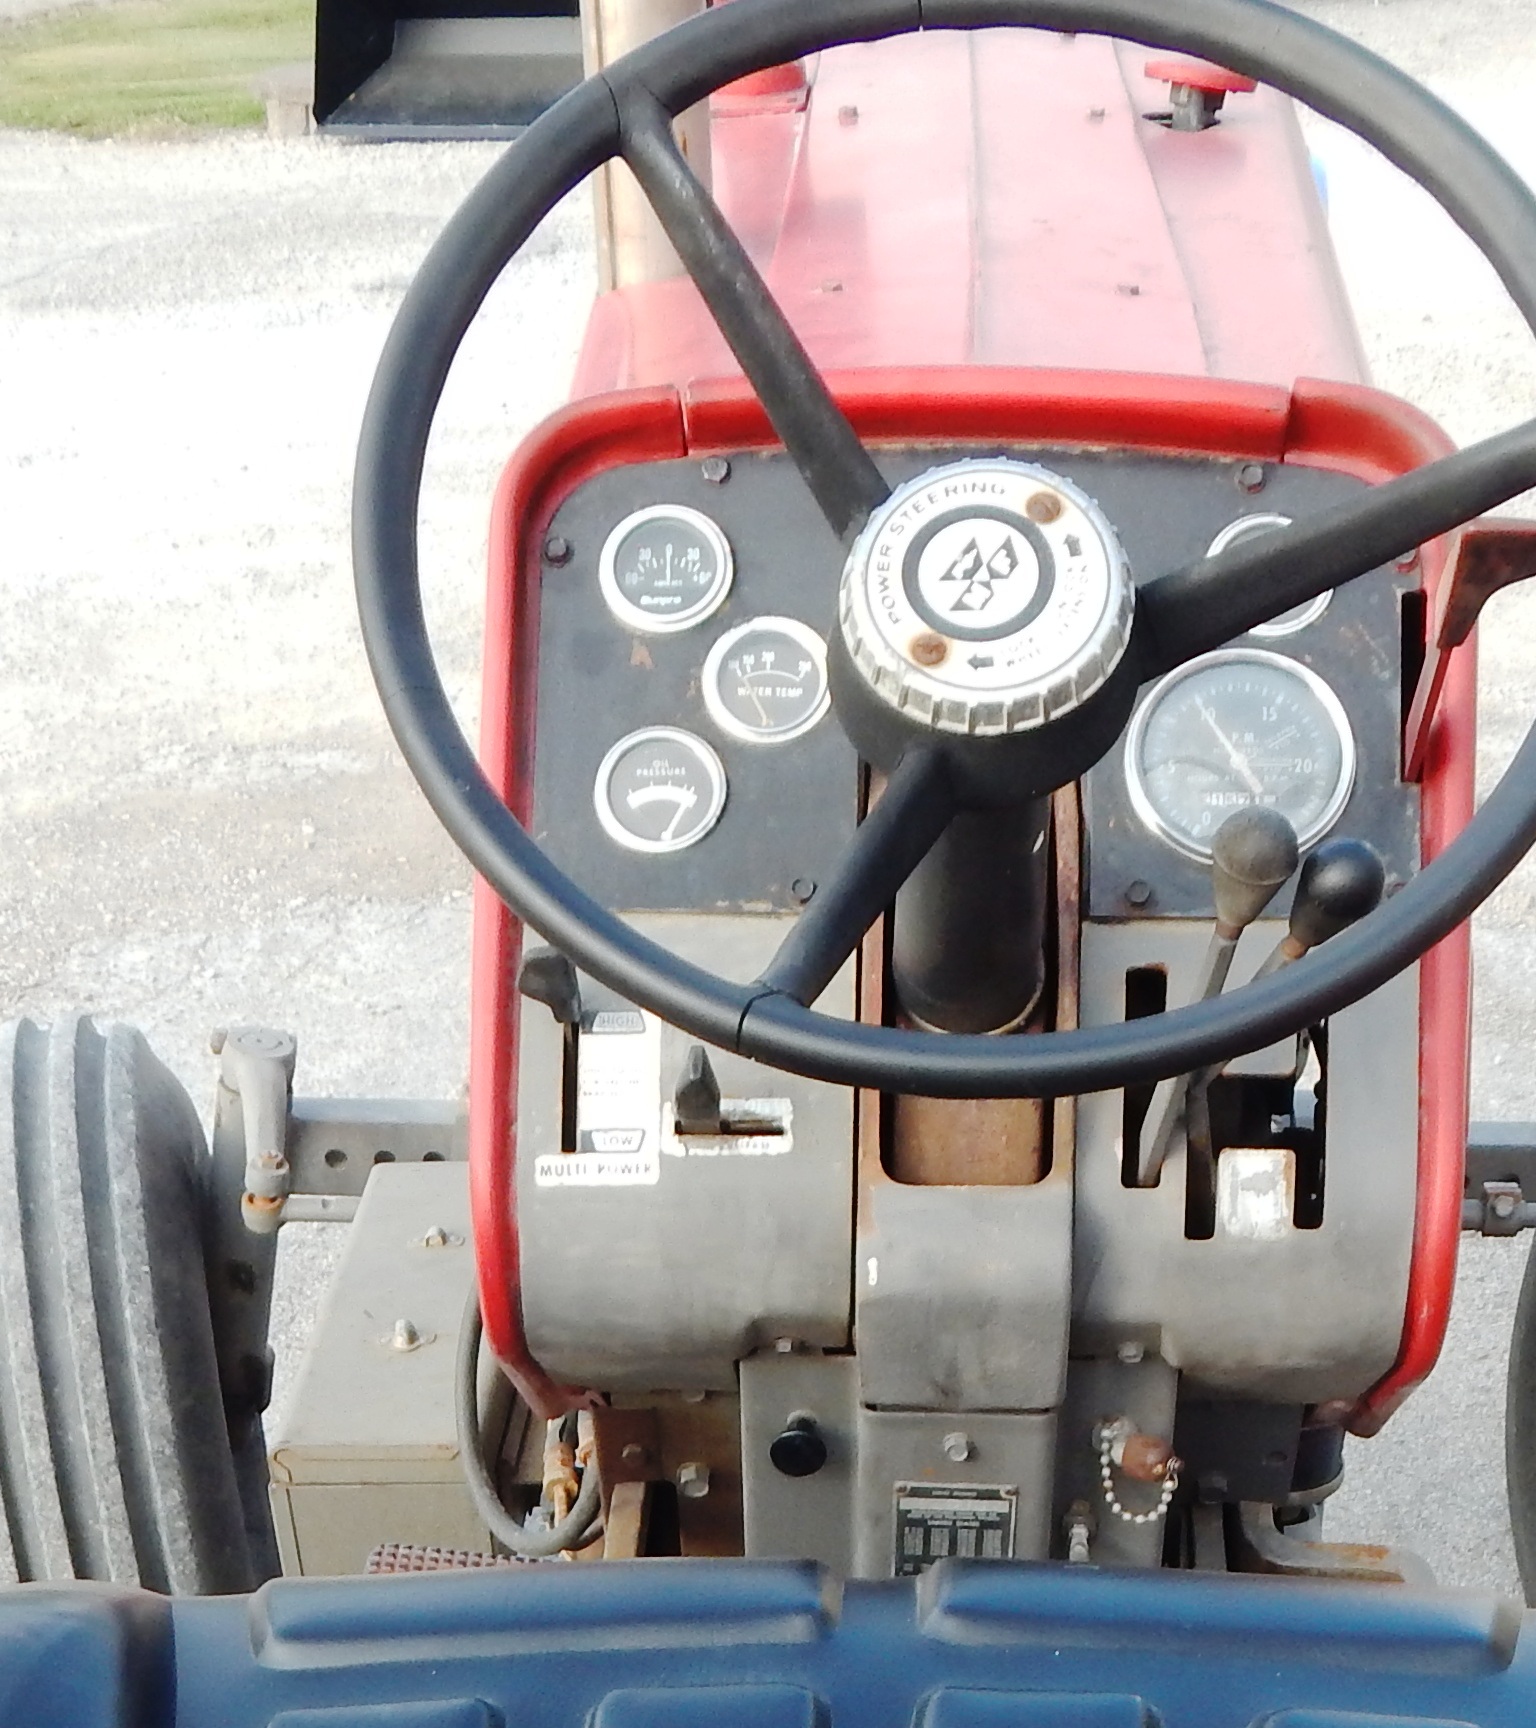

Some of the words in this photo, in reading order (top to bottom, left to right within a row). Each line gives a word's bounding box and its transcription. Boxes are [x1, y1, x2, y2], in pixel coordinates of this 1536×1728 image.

[877, 544, 902, 625] POWER
[890, 481, 1007, 536] STEERING
[737, 687, 772, 697] WATER
[775, 687, 803, 698] TEMP
[1262, 706, 1277, 721] 15
[636, 767, 686, 777] PRESSURE
[1294, 759, 1312, 774] 20
[598, 1014, 637, 1027] HIGH
[602, 1135, 634, 1147] LOW
[539, 1164, 587, 1178] MULTI
[597, 1162, 652, 1176] POWER
